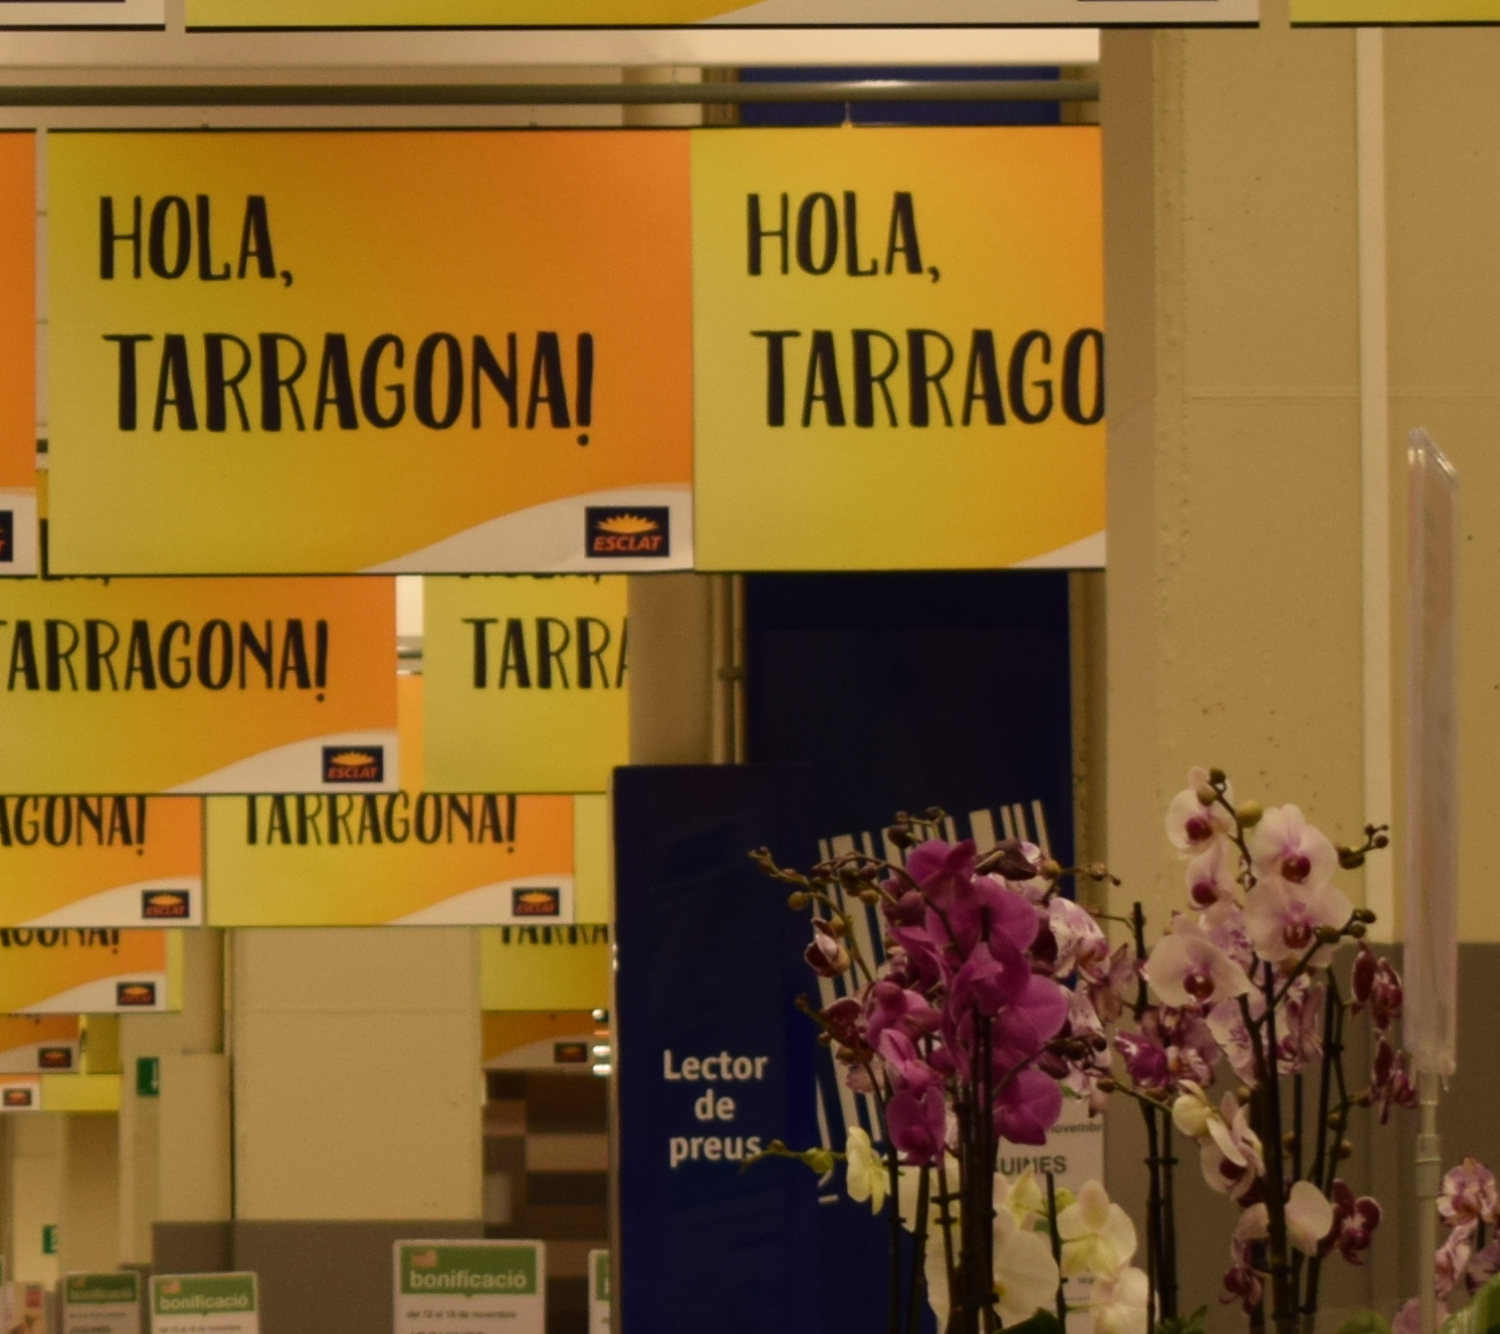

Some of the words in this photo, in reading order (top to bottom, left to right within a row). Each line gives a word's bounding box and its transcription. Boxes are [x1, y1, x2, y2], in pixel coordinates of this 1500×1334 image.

[98, 194, 293, 288] HOLA,
[746, 190, 941, 284] HOLA,
[102, 332, 594, 447] TARRAGONA!
[749, 327, 1106, 427] TARRAGO
[593, 535, 663, 552] ESCLAT
[245, 794, 518, 855] TARRAGONA!
[661, 1049, 769, 1082] Lector
[694, 1088, 737, 1123] de
[668, 1135, 763, 1169] preus
[410, 1269, 527, 1288] bonificació
